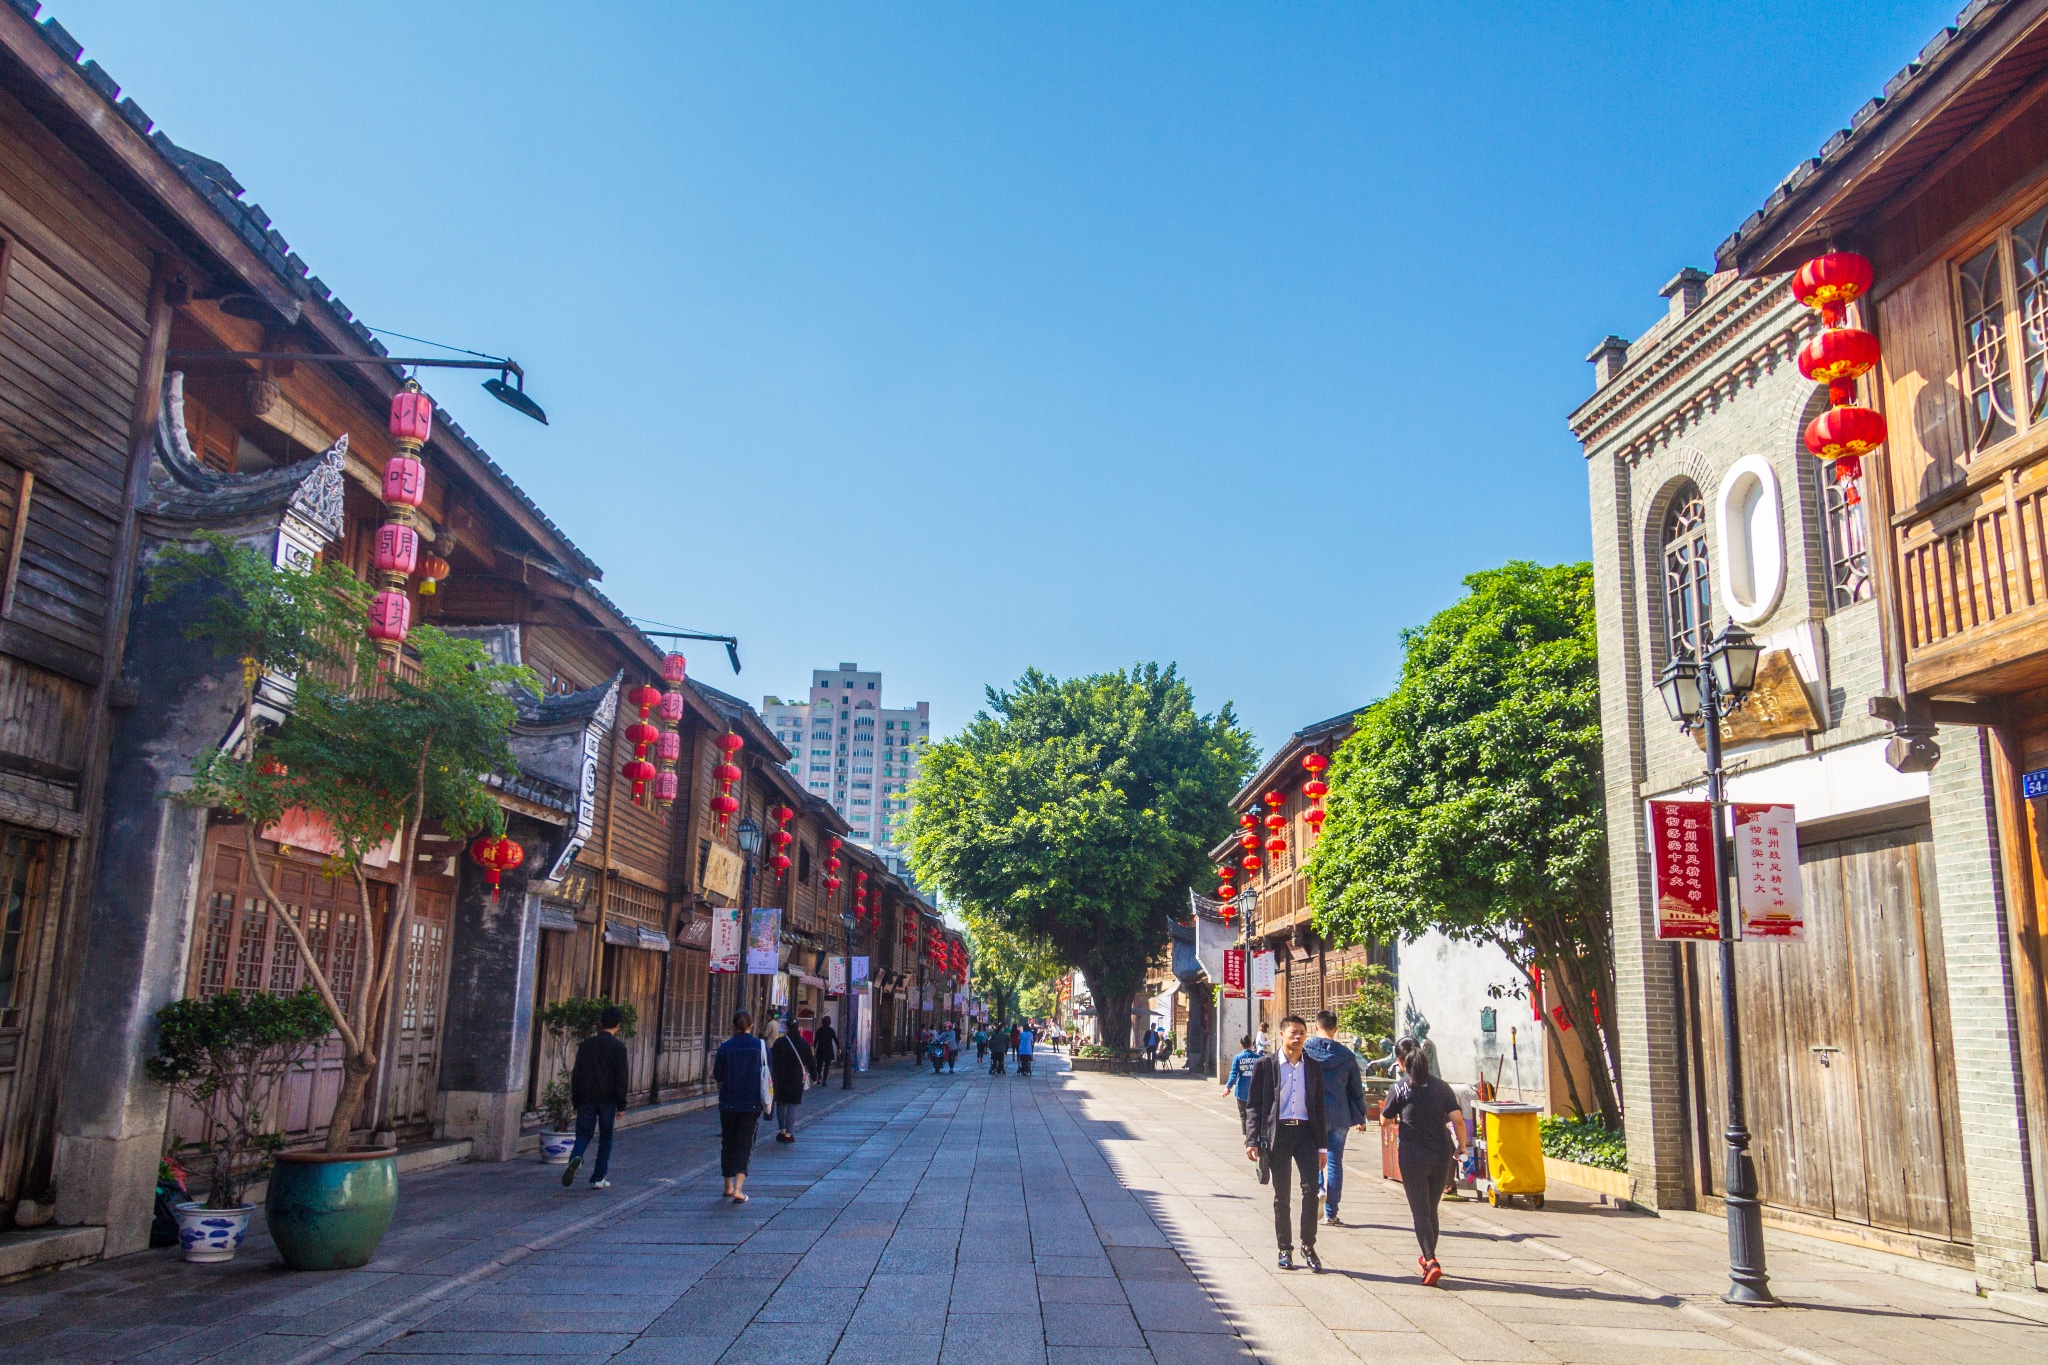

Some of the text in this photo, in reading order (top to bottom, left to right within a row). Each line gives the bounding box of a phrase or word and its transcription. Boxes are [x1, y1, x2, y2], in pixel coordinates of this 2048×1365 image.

[1665, 804, 1684, 887] 贯彻落实十九大
[1683, 819, 1702, 900] 福州鼓足精气神
[1748, 813, 1766, 893] 贯彻落实十九大
[1767, 827, 1784, 908] 福州鼓足精气神
